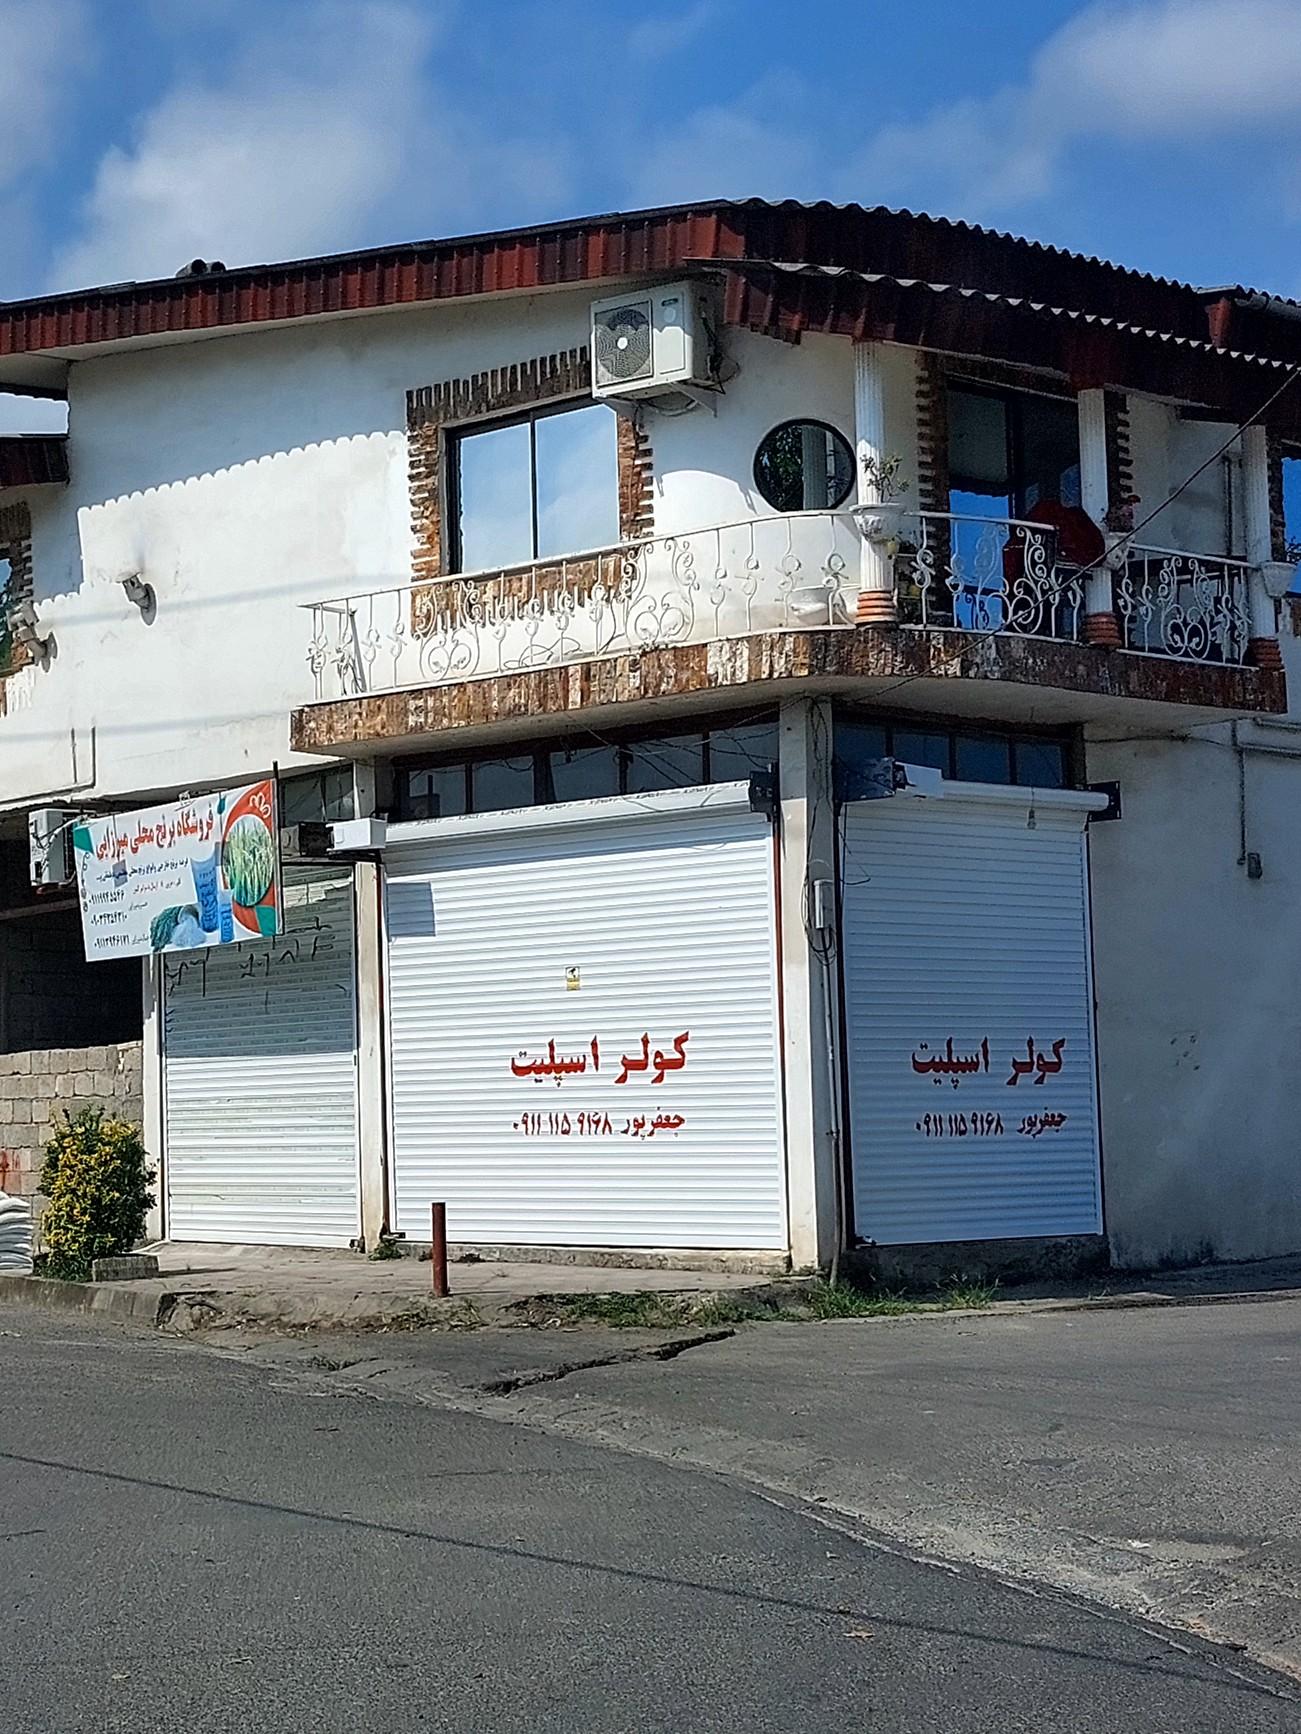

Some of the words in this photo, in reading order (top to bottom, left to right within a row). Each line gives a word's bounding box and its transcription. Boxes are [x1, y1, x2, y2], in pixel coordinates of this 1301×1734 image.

[130, 819, 154, 854] محلی
[155, 813, 176, 848] برنج
[176, 803, 215, 843] فروشگاه
[510, 1035, 600, 1088] اسپلیت
[614, 1031, 690, 1085] کولر
[911, 1036, 990, 1090] اسپلیت
[1006, 1036, 1066, 1086] کولر
[513, 1112, 541, 1136] ۰۹۱۱
[548, 1112, 571, 1136] ۱۱۵
[577, 1111, 613, 1136] ۹۱۶۸
[620, 1106, 686, 1140] جعفرپور
[915, 1112, 943, 1137] ۰۹۱۱
[948, 1112, 968, 1137] ۱۱۵
[970, 1112, 1004, 1136] ۹۱۶۸
[1016, 1106, 1067, 1139] جعفرپور
